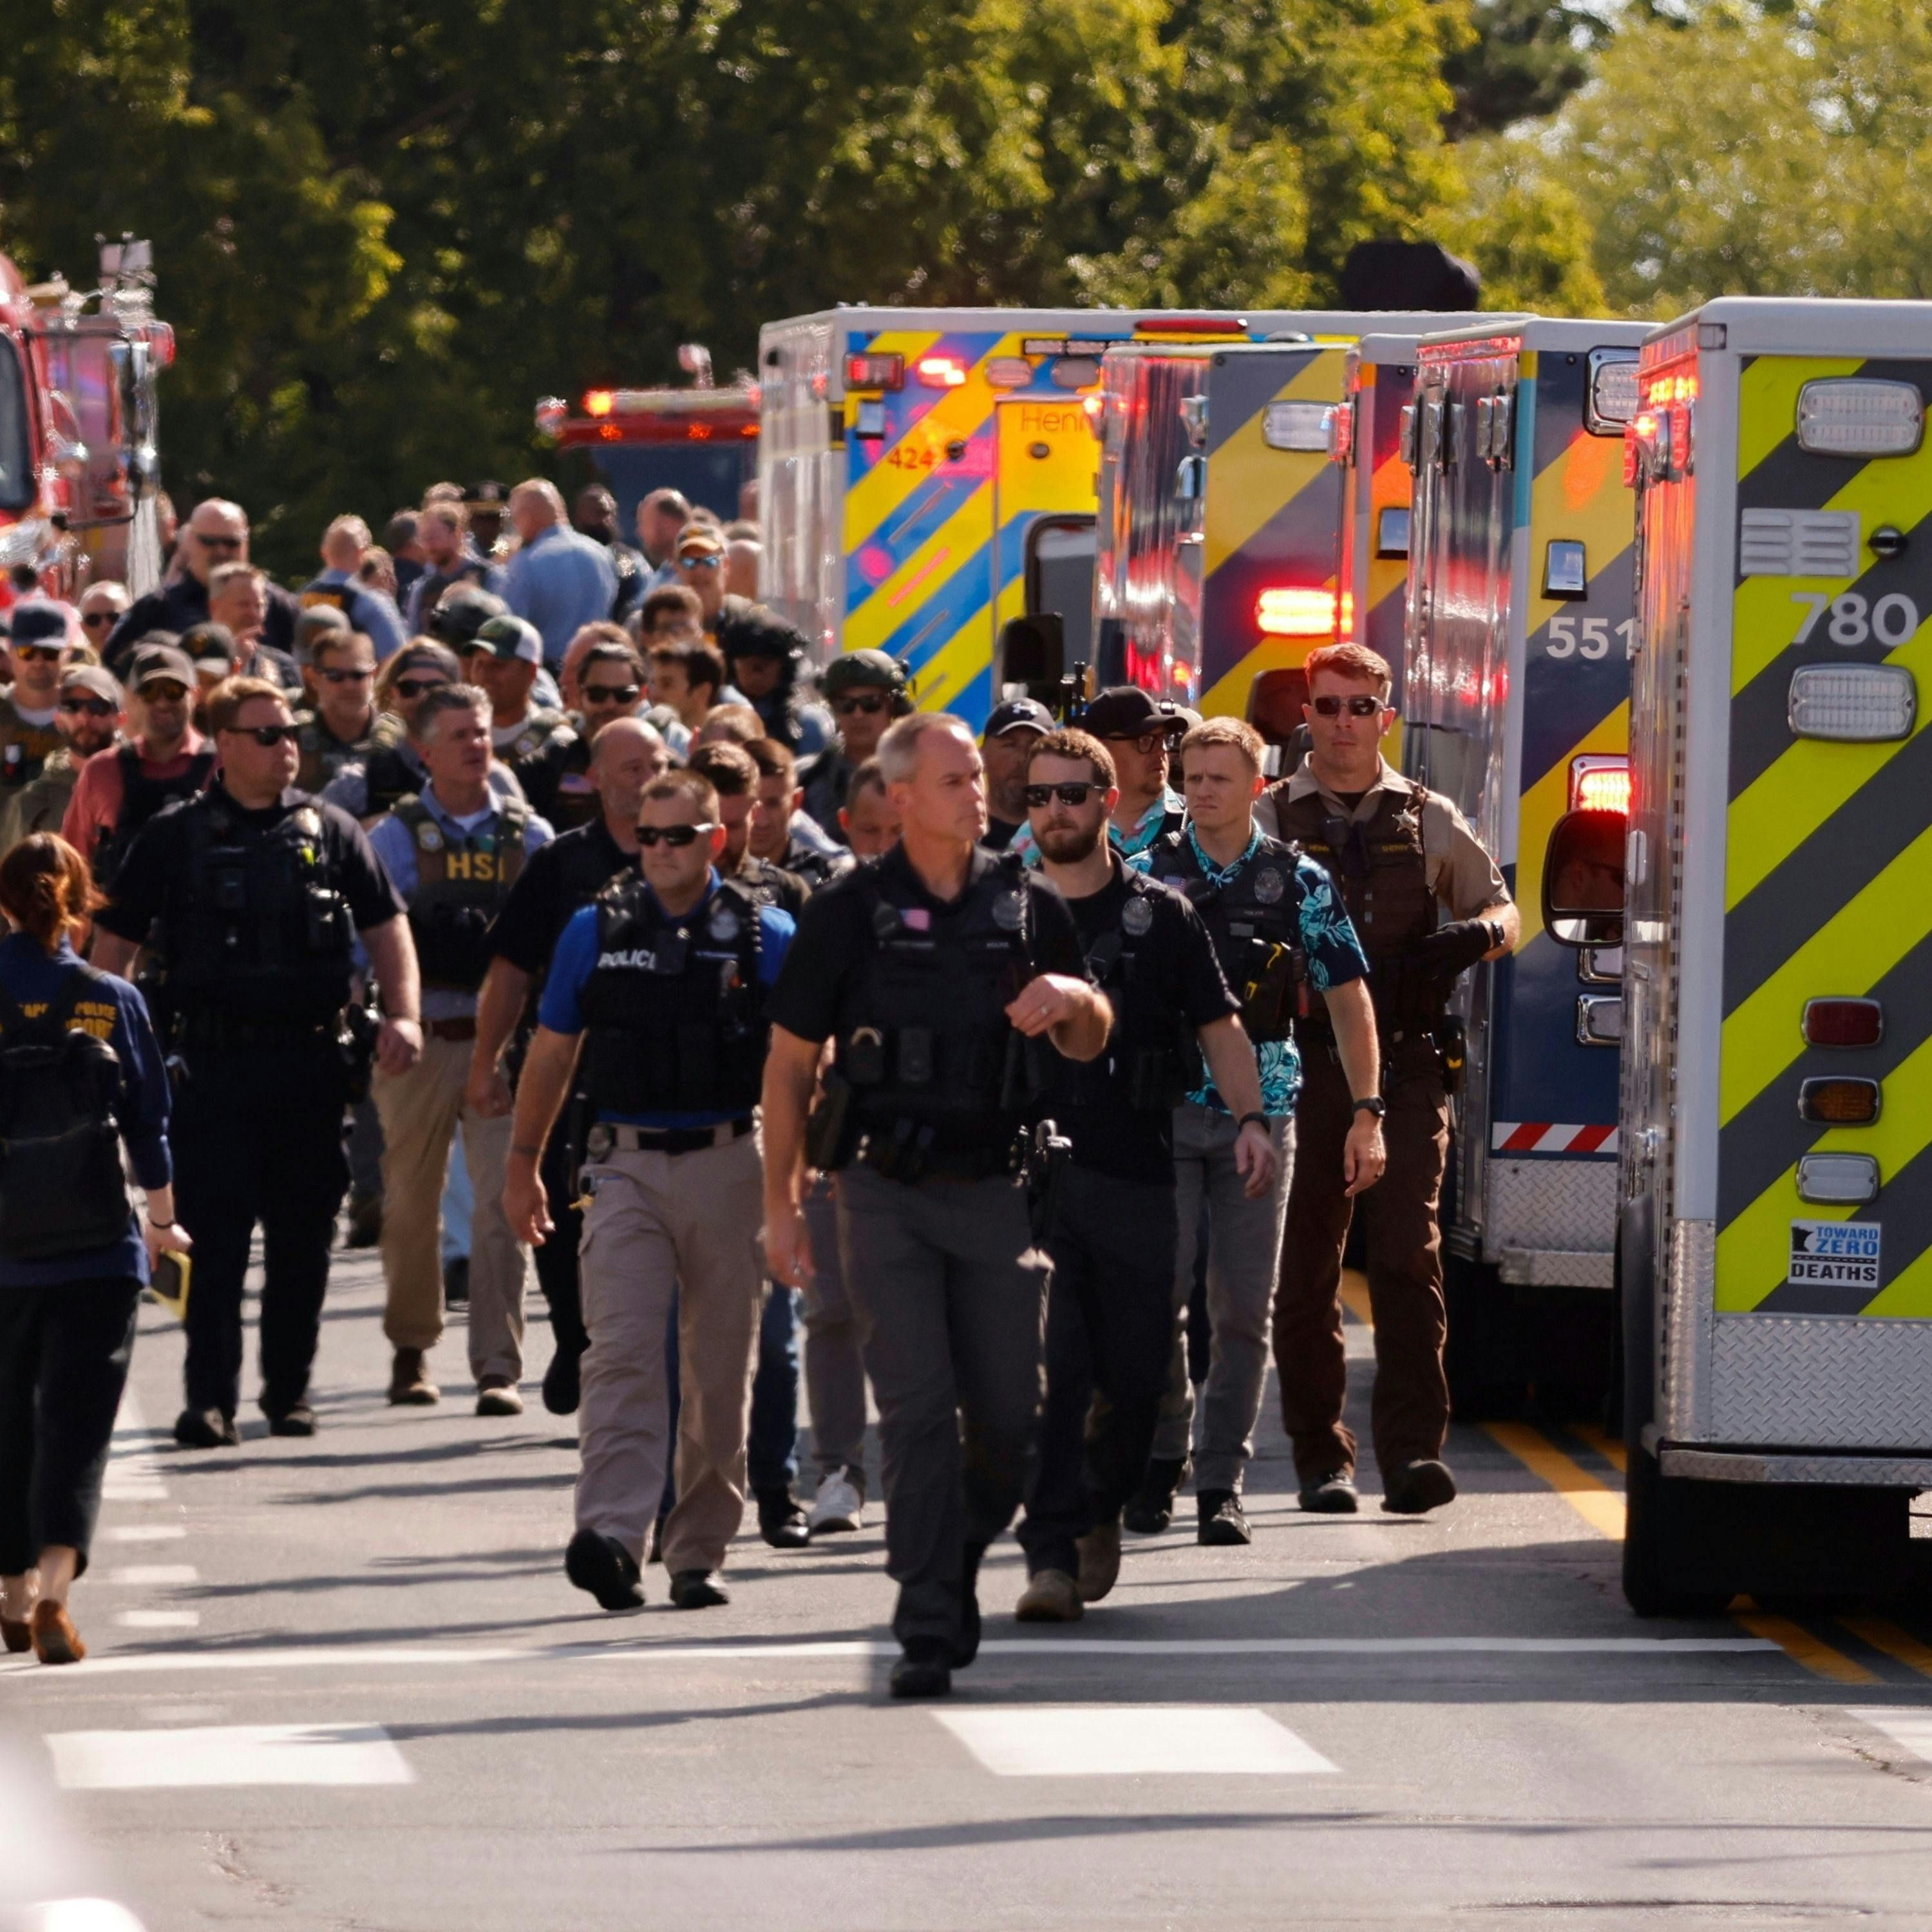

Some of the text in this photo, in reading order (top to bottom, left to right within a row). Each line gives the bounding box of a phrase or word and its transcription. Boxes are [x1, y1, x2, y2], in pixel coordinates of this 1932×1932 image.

[1020, 406, 1084, 432] Hen
[888, 446, 935, 469] 424
[1790, 592, 1918, 645] 780
[1546, 616, 1634, 661] 551
[1816, 1226, 1879, 1240] TOWARD
[1815, 1238, 1878, 1256] ZERO
[1790, 1263, 1877, 1282] DEATHS
